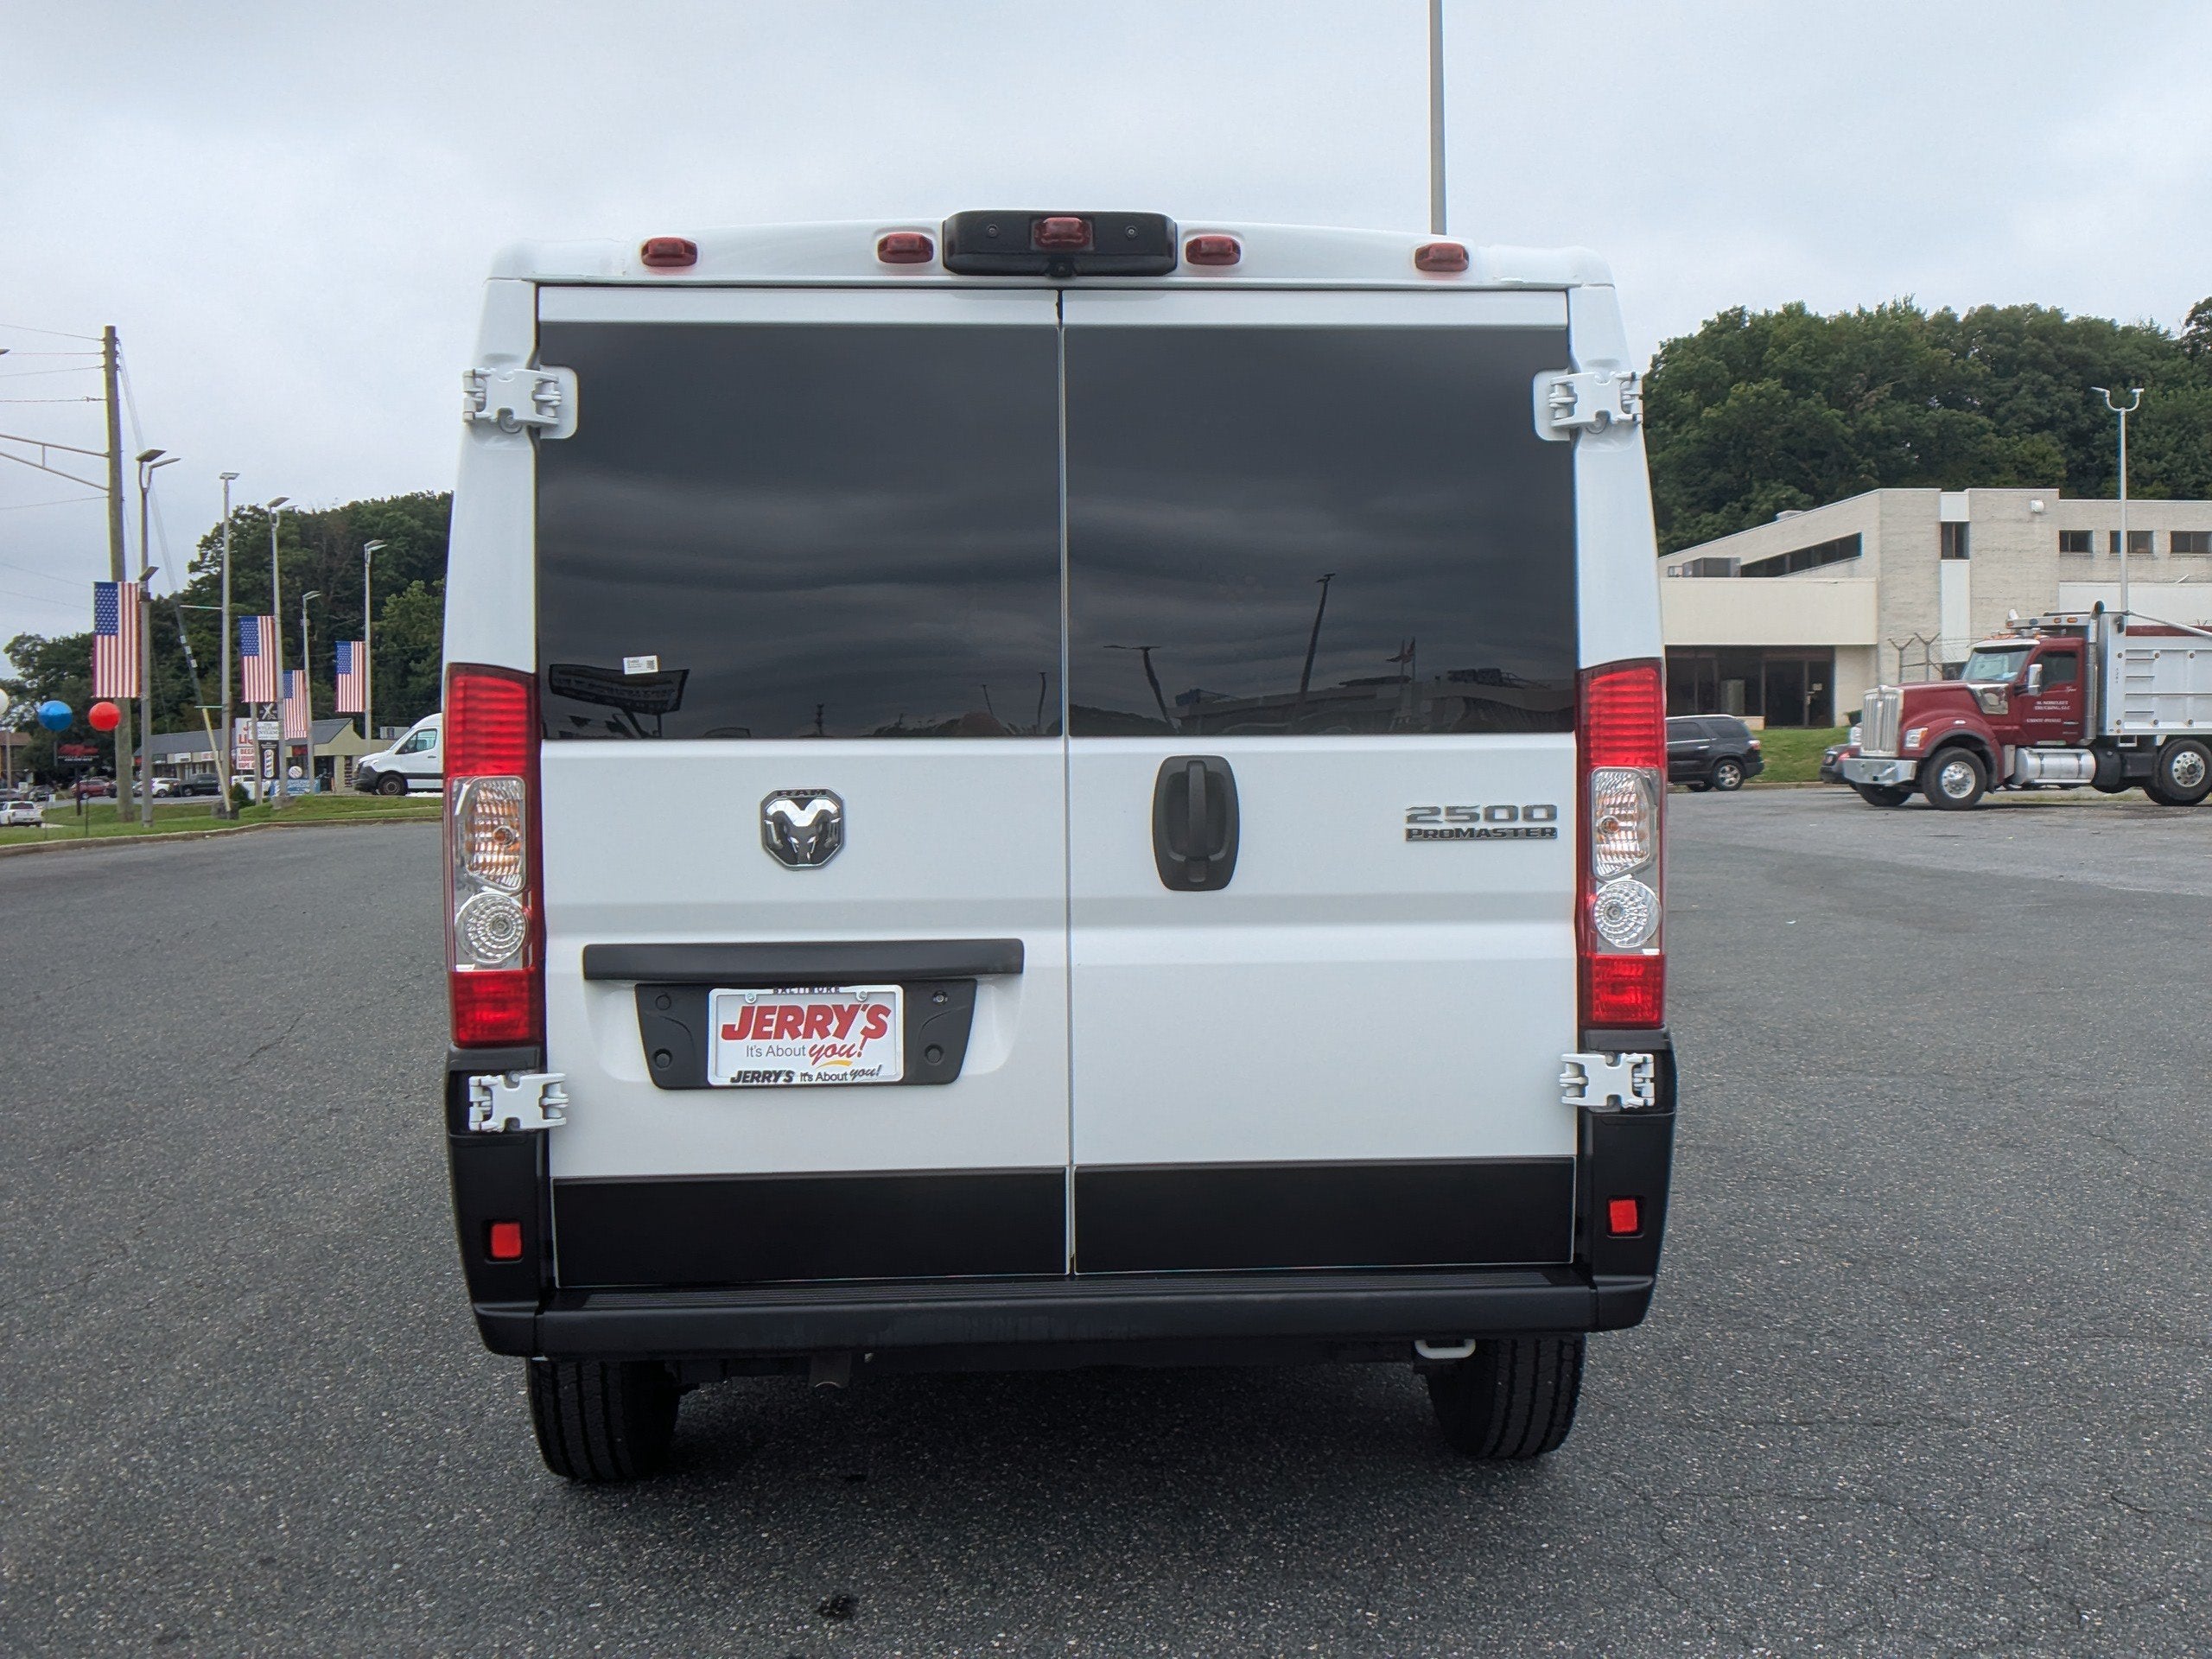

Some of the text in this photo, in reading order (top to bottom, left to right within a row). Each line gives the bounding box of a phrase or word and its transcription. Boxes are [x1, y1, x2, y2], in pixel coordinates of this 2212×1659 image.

[1406, 804, 1558, 823] 2500
[1406, 827, 1558, 841] PROMASTER
[721, 1004, 892, 1040] JERRY'S
[746, 1037, 868, 1065] It's About you!
[730, 1065, 882, 1084] JERRY'S It's About you!
